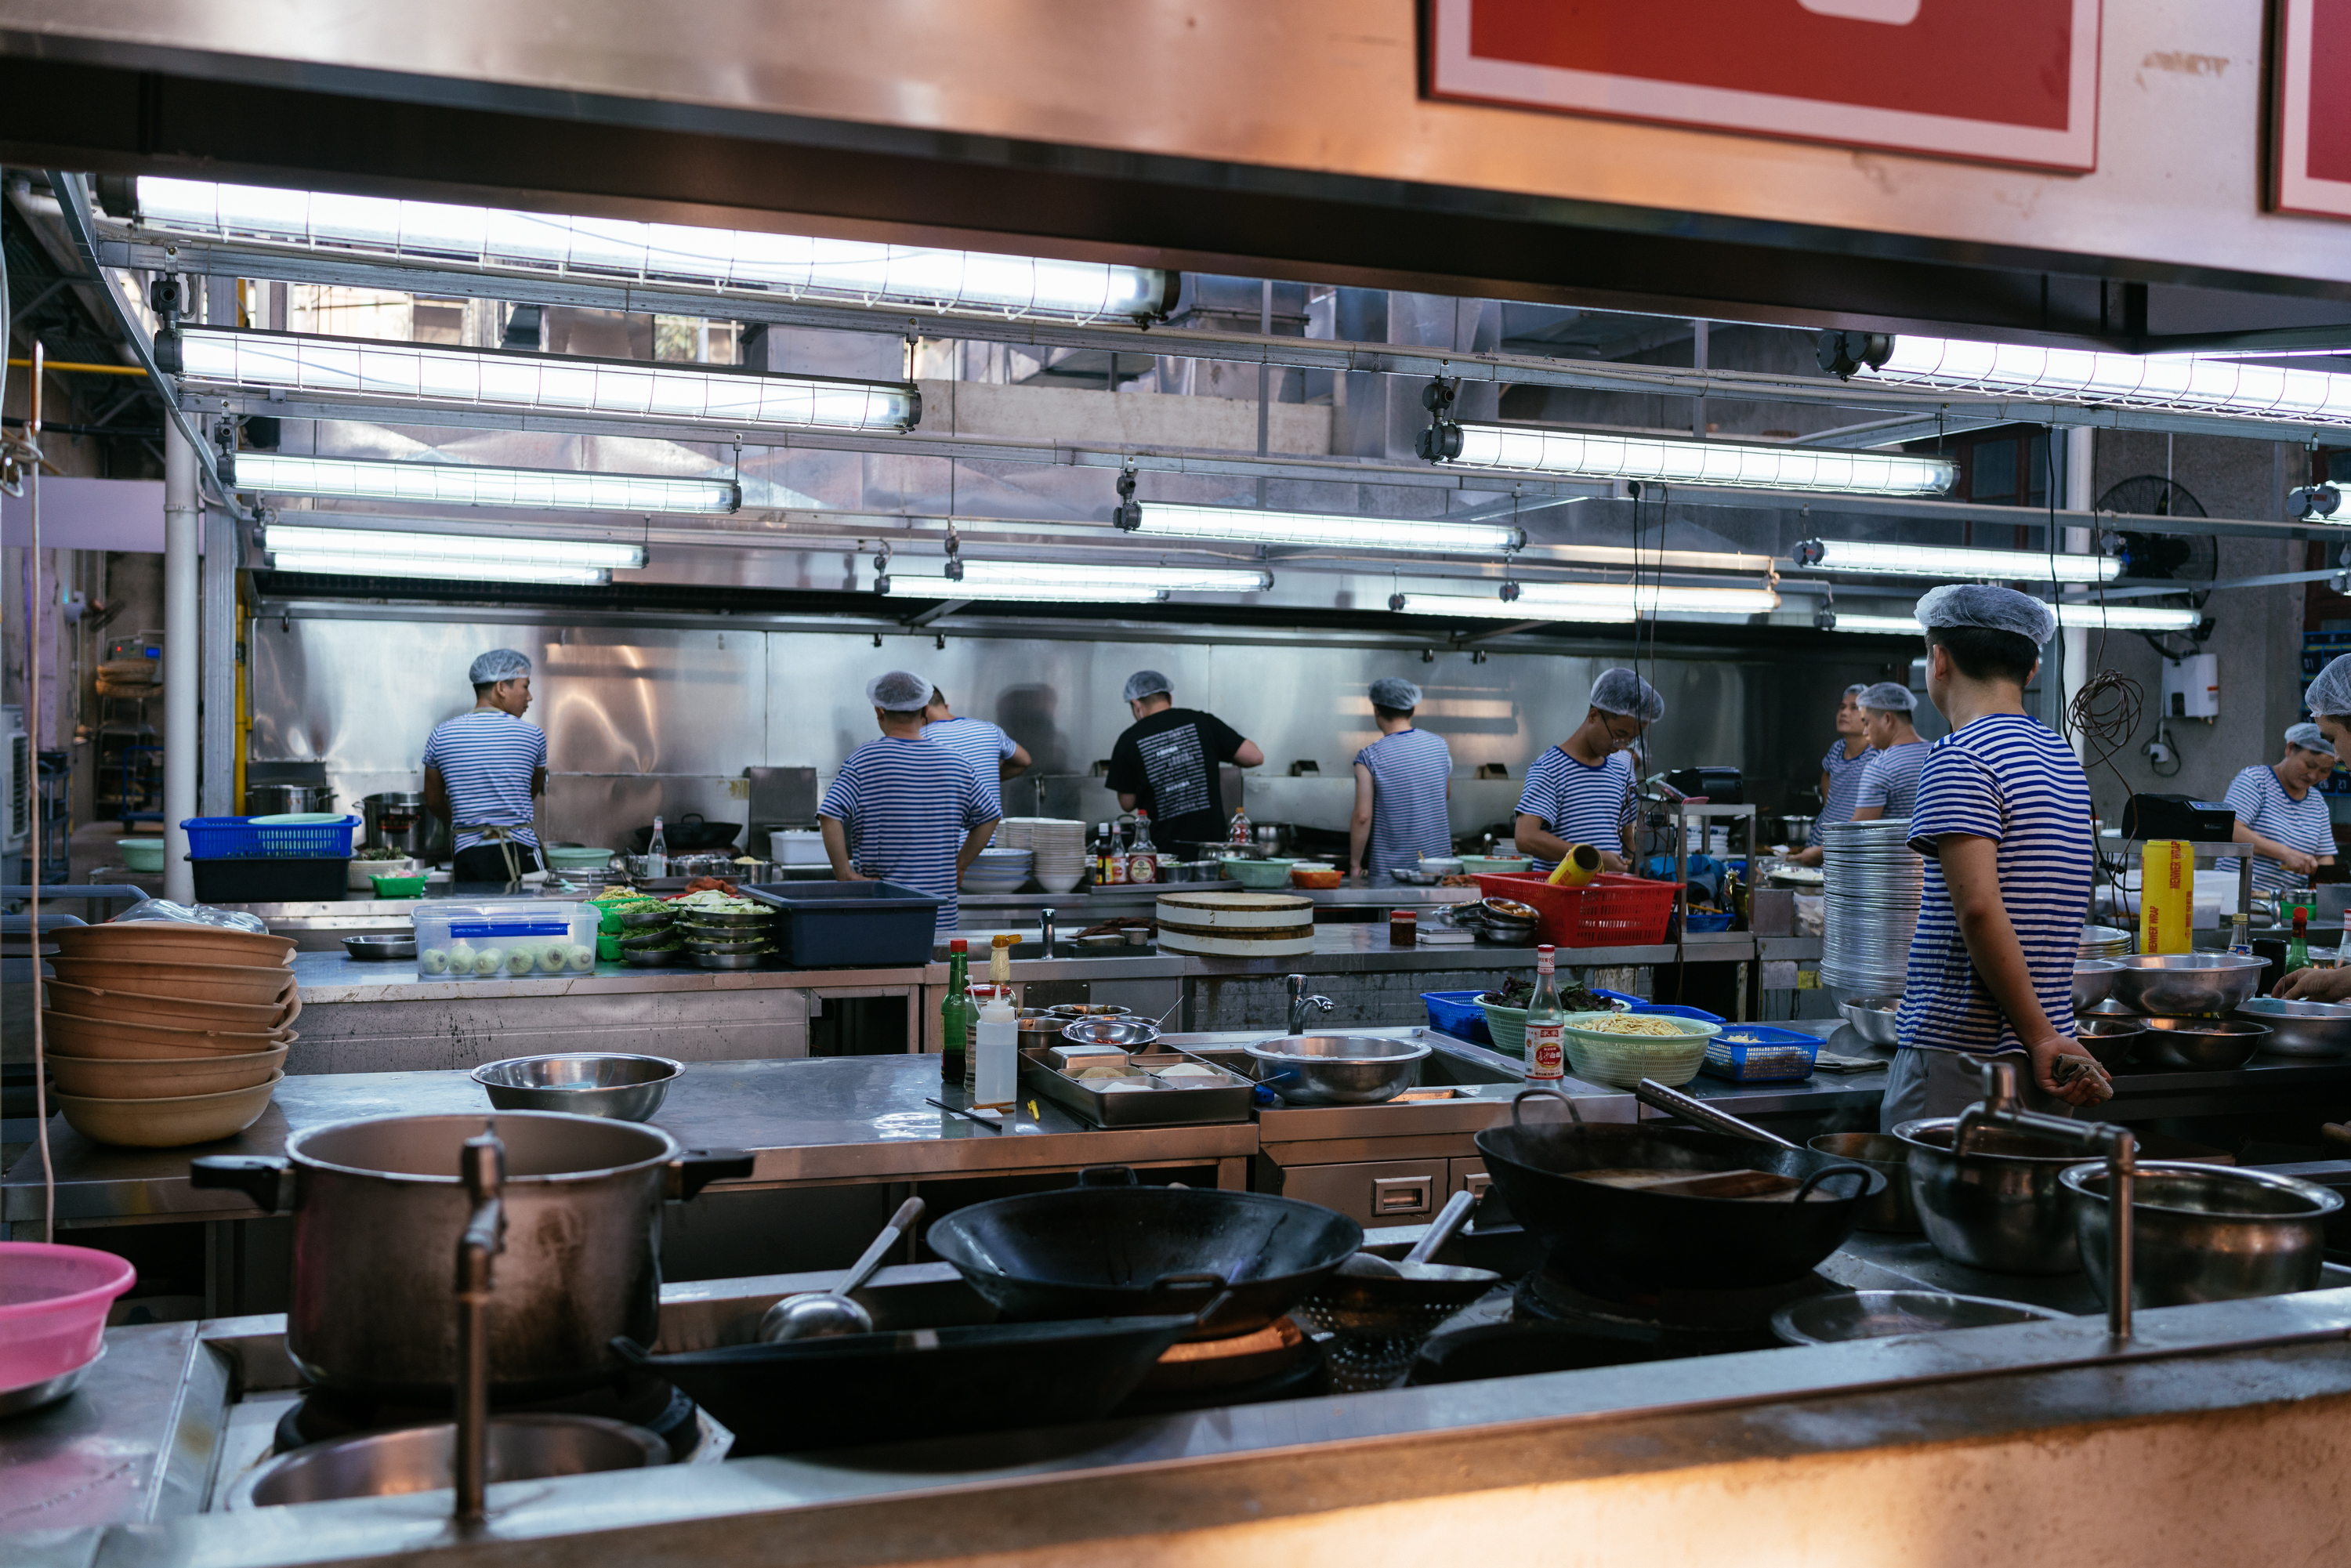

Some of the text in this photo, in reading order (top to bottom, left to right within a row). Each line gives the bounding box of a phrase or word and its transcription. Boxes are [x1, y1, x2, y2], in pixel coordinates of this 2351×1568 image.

[2304, 657, 2314, 669] 01
[2171, 841, 2181, 860] WRAP
[2149, 905, 2159, 924] WRAP
